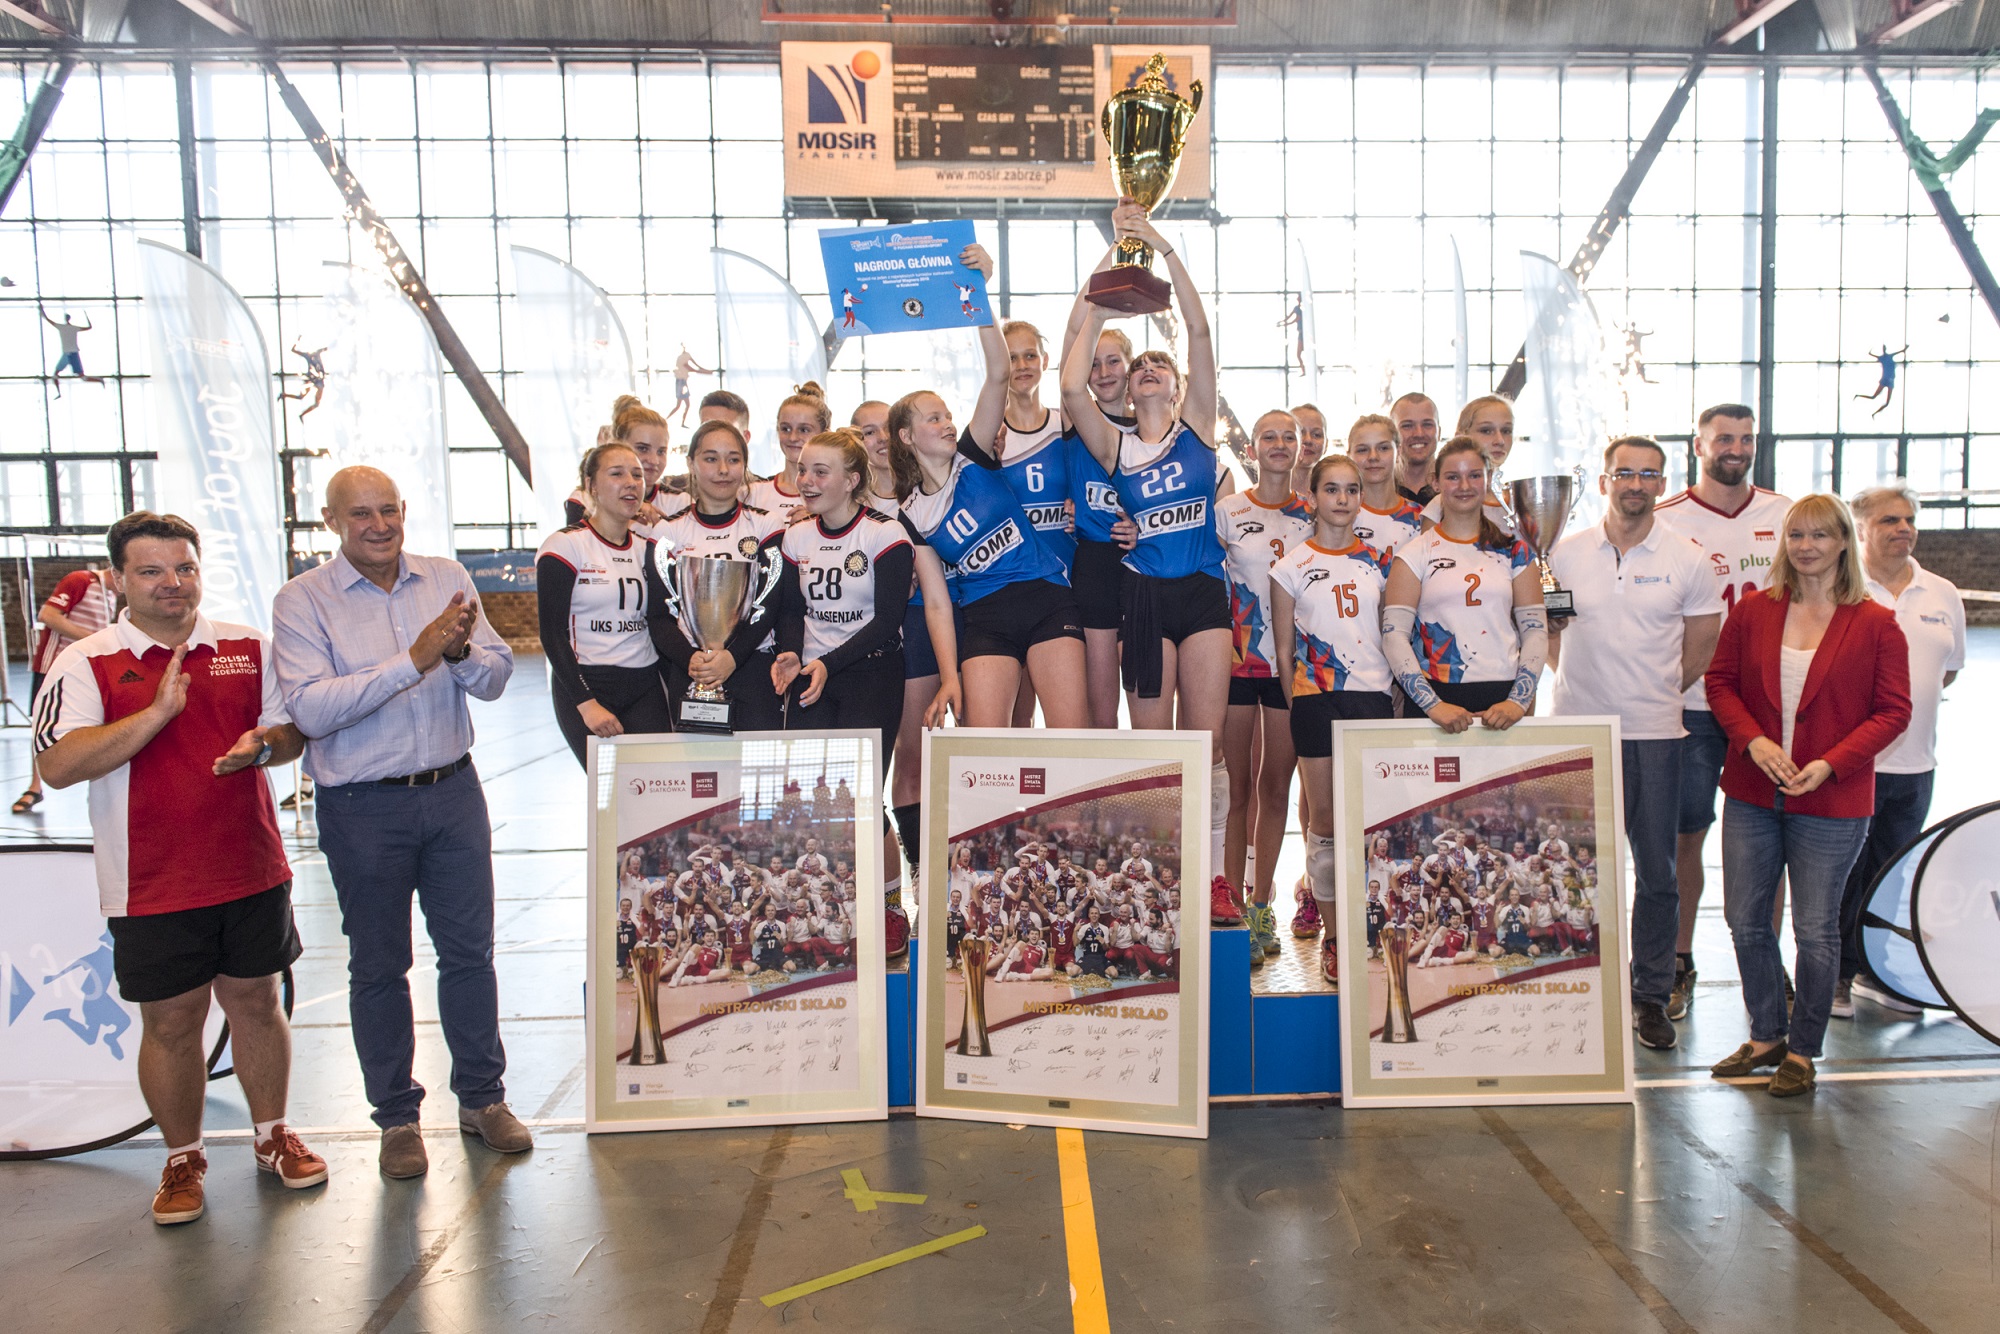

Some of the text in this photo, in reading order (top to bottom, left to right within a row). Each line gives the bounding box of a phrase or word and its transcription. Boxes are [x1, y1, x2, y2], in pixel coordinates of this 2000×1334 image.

[798, 132, 877, 150] MOSiR
[936, 168, 1056, 184] www.mosir.zabrze.pl
[854, 255, 953, 273] NAGRODA GŁÓWNA
[1026, 463, 1045, 493] 6
[1140, 461, 1187, 499] 22
[946, 509, 979, 544] 10
[1740, 553, 1772, 571] plus
[808, 567, 842, 600] 28
[1464, 573, 1482, 607] 2
[618, 577, 644, 611] 17
[1332, 583, 1359, 619] 15
[591, 620, 613, 633] UKS
[208, 662, 257, 670] VOLLEYBALL
[212, 655, 249, 664] POLISH
[210, 668, 258, 677] FEDERATION
[619, 934, 629, 944] 10
[766, 939, 775, 949] 17
[1089, 943, 1098, 953] 17
[1448, 980, 1591, 997] MISTRZOWSKI SKŁAD
[699, 997, 848, 1015] MISTRZOWSKI SKŁAD
[1023, 1000, 1169, 1021] MISTRZOWSKI SKŁAD
